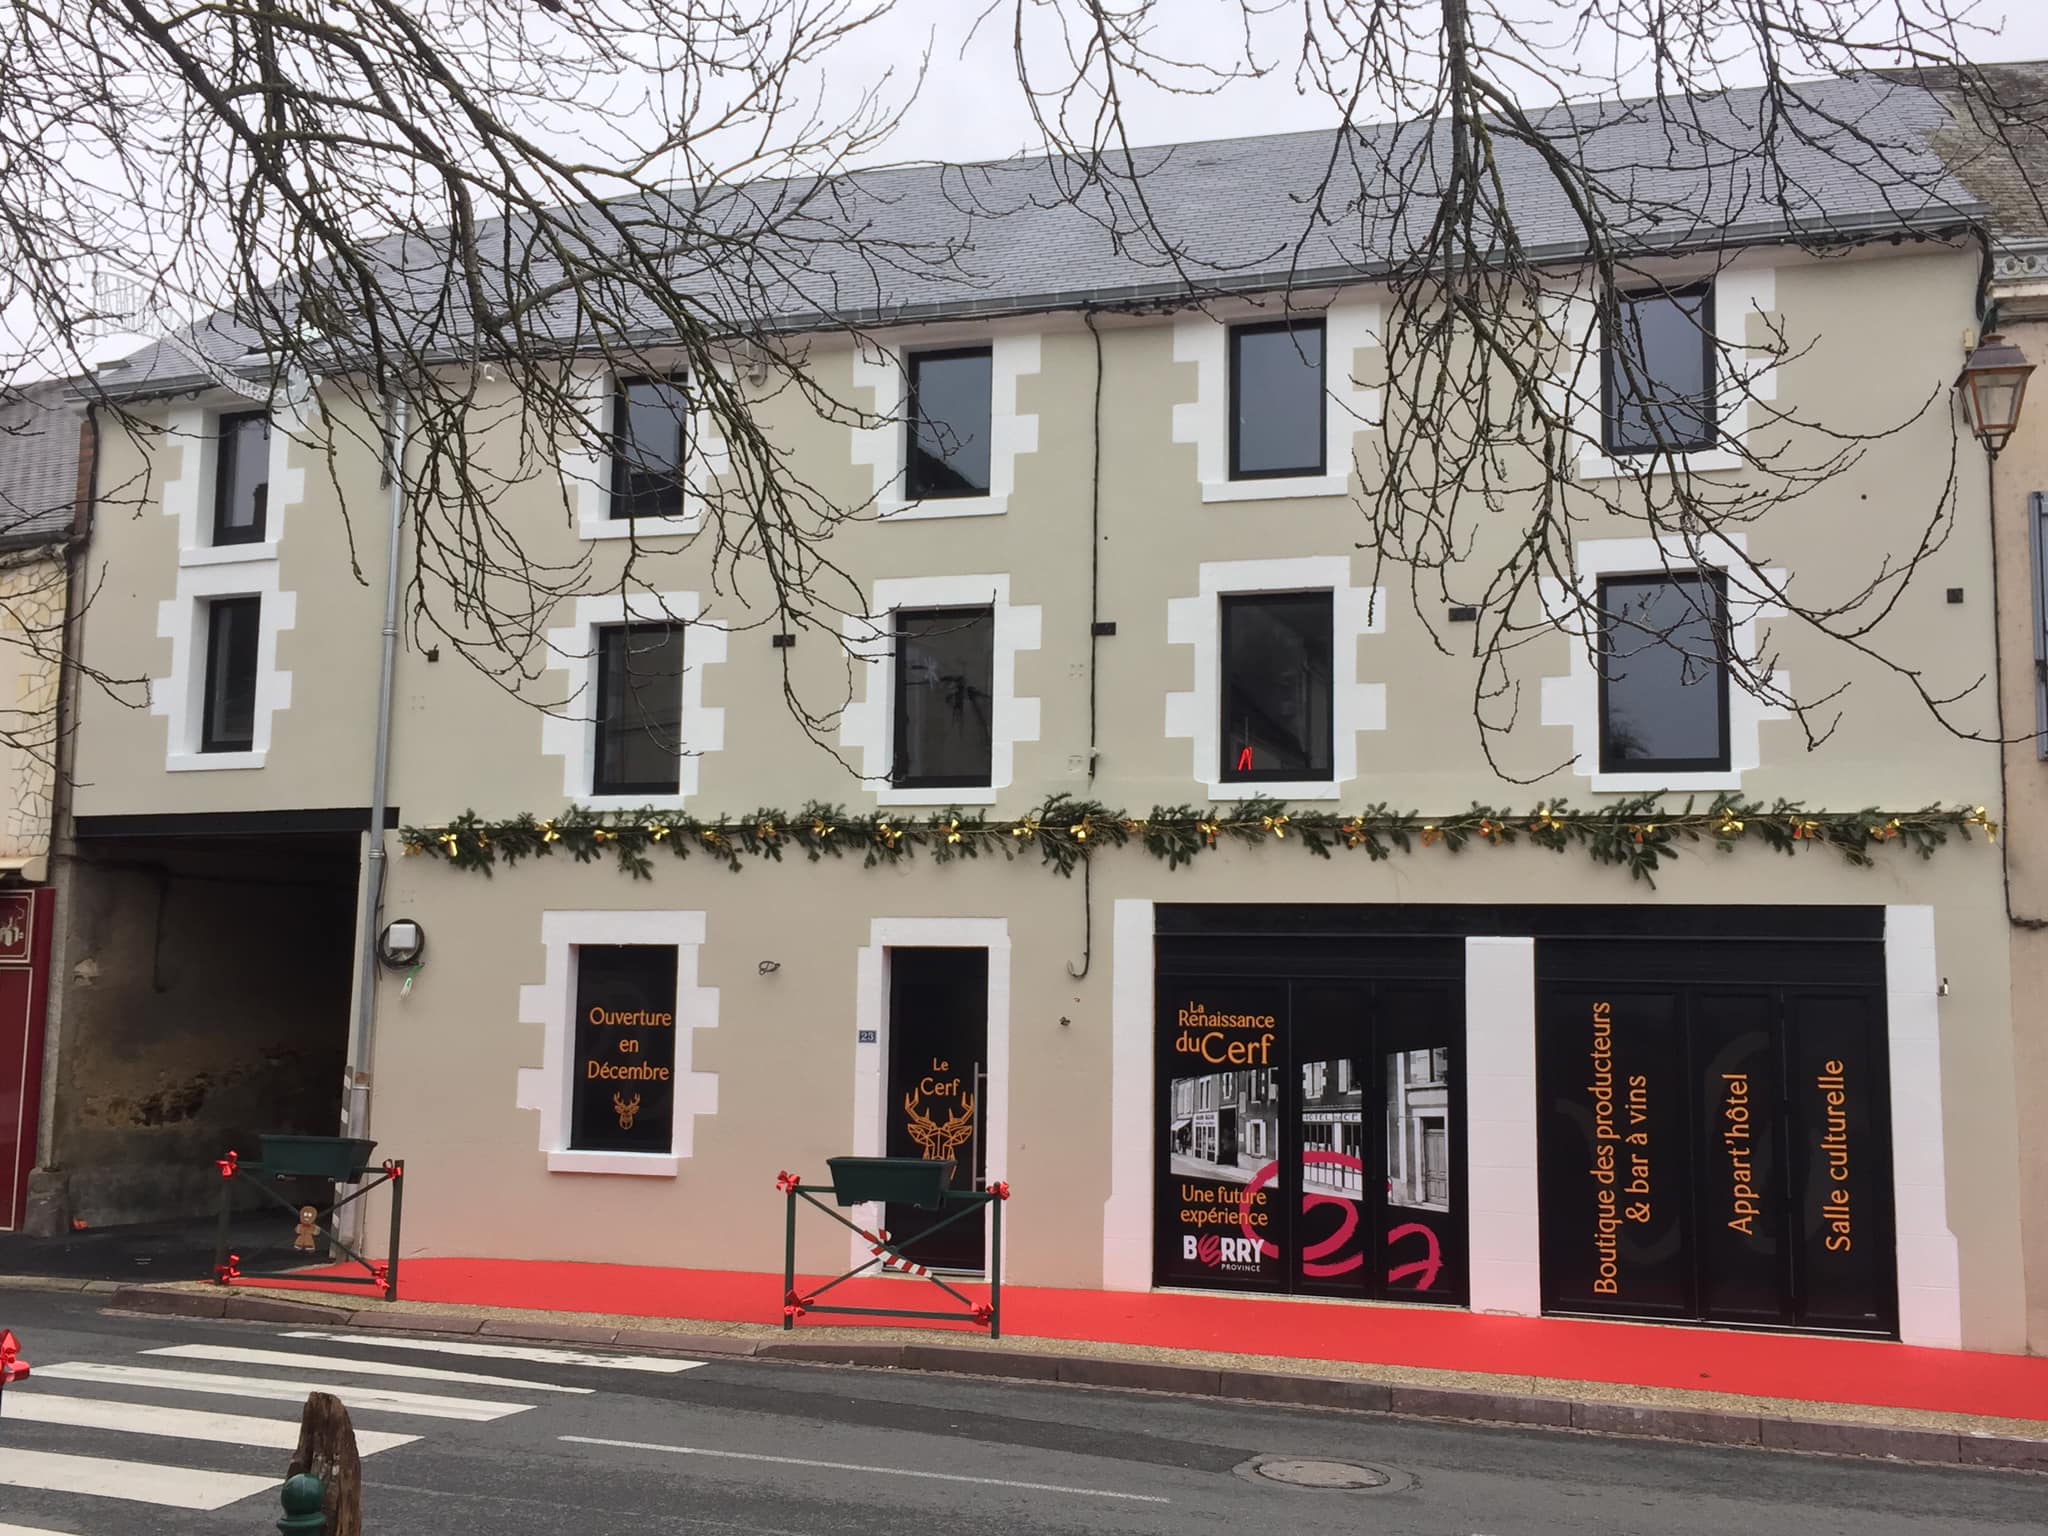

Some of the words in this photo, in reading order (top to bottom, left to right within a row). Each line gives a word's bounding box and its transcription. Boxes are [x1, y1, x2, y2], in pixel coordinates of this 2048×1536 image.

[589, 1007, 672, 1026] Ouverture
[1190, 1001, 1205, 1014] La
[1178, 1008, 1275, 1029] Renaissance
[619, 1038, 639, 1054] en
[860, 1032, 874, 1042] 23
[1175, 1031, 1201, 1053] du
[1201, 1032, 1275, 1065] Cerf
[587, 1060, 670, 1081] Décembre
[932, 1058, 949, 1072] Le
[1587, 1001, 1621, 1141] producteurs
[920, 1077, 961, 1097] Cerf
[1624, 1075, 1649, 1124] vins
[1817, 1060, 1849, 1181] culturelle
[1625, 1133, 1649, 1146] à
[1589, 1144, 1616, 1185] des
[1721, 1073, 1760, 1236] Appart’hôtel
[1624, 1154, 1650, 1195] bar
[1182, 1184, 1214, 1202] Une
[1217, 1186, 1267, 1205] future
[1180, 1207, 1269, 1228] expérience
[1625, 1202, 1650, 1223] &
[1822, 1190, 1851, 1252] Salle
[1183, 1233, 1265, 1268] BERRY
[1593, 1190, 1623, 1295] Boutique
[1220, 1263, 1262, 1273] PROVINCE
